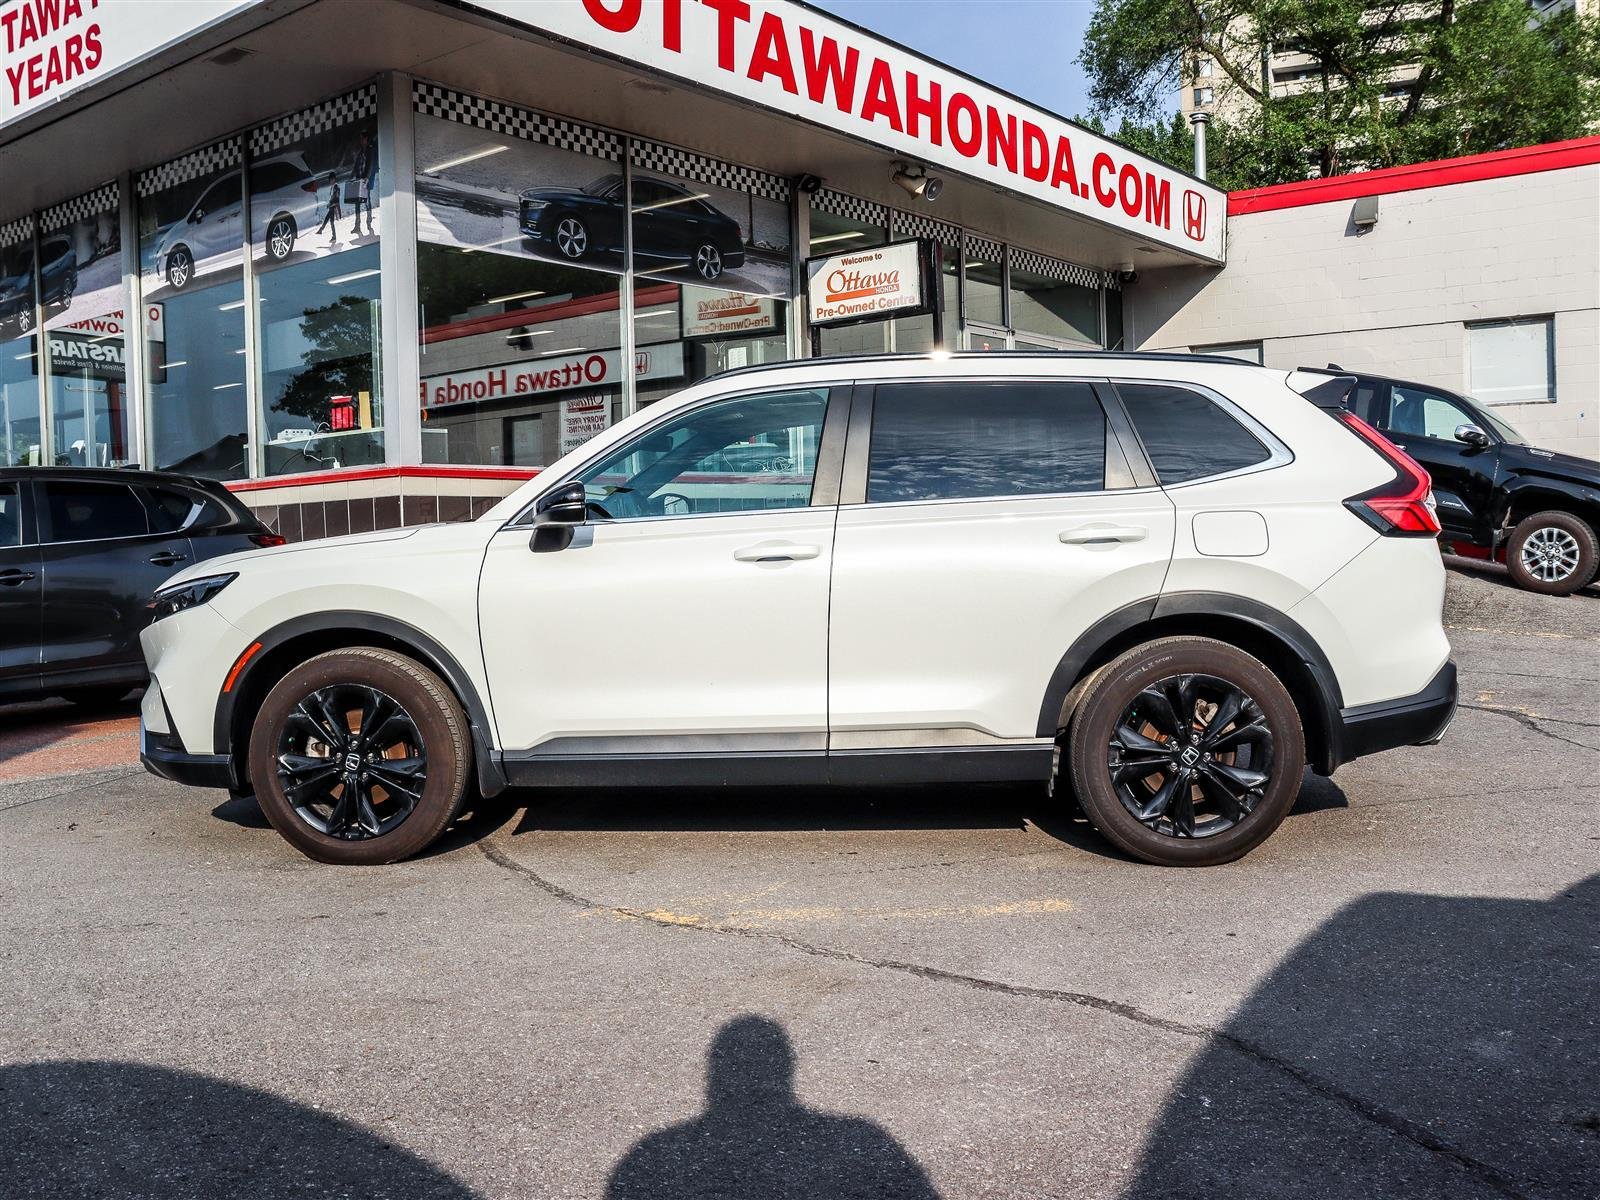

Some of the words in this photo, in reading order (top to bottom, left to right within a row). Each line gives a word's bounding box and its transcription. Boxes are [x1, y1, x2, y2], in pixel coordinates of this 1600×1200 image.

[5, 23, 103, 106] YEARS
[841, 255, 873, 267] Welcome
[875, 252, 883, 261] to
[826, 269, 900, 293] Ottawa
[875, 285, 898, 295] HONDA
[816, 300, 876, 319] Pre-Owned
